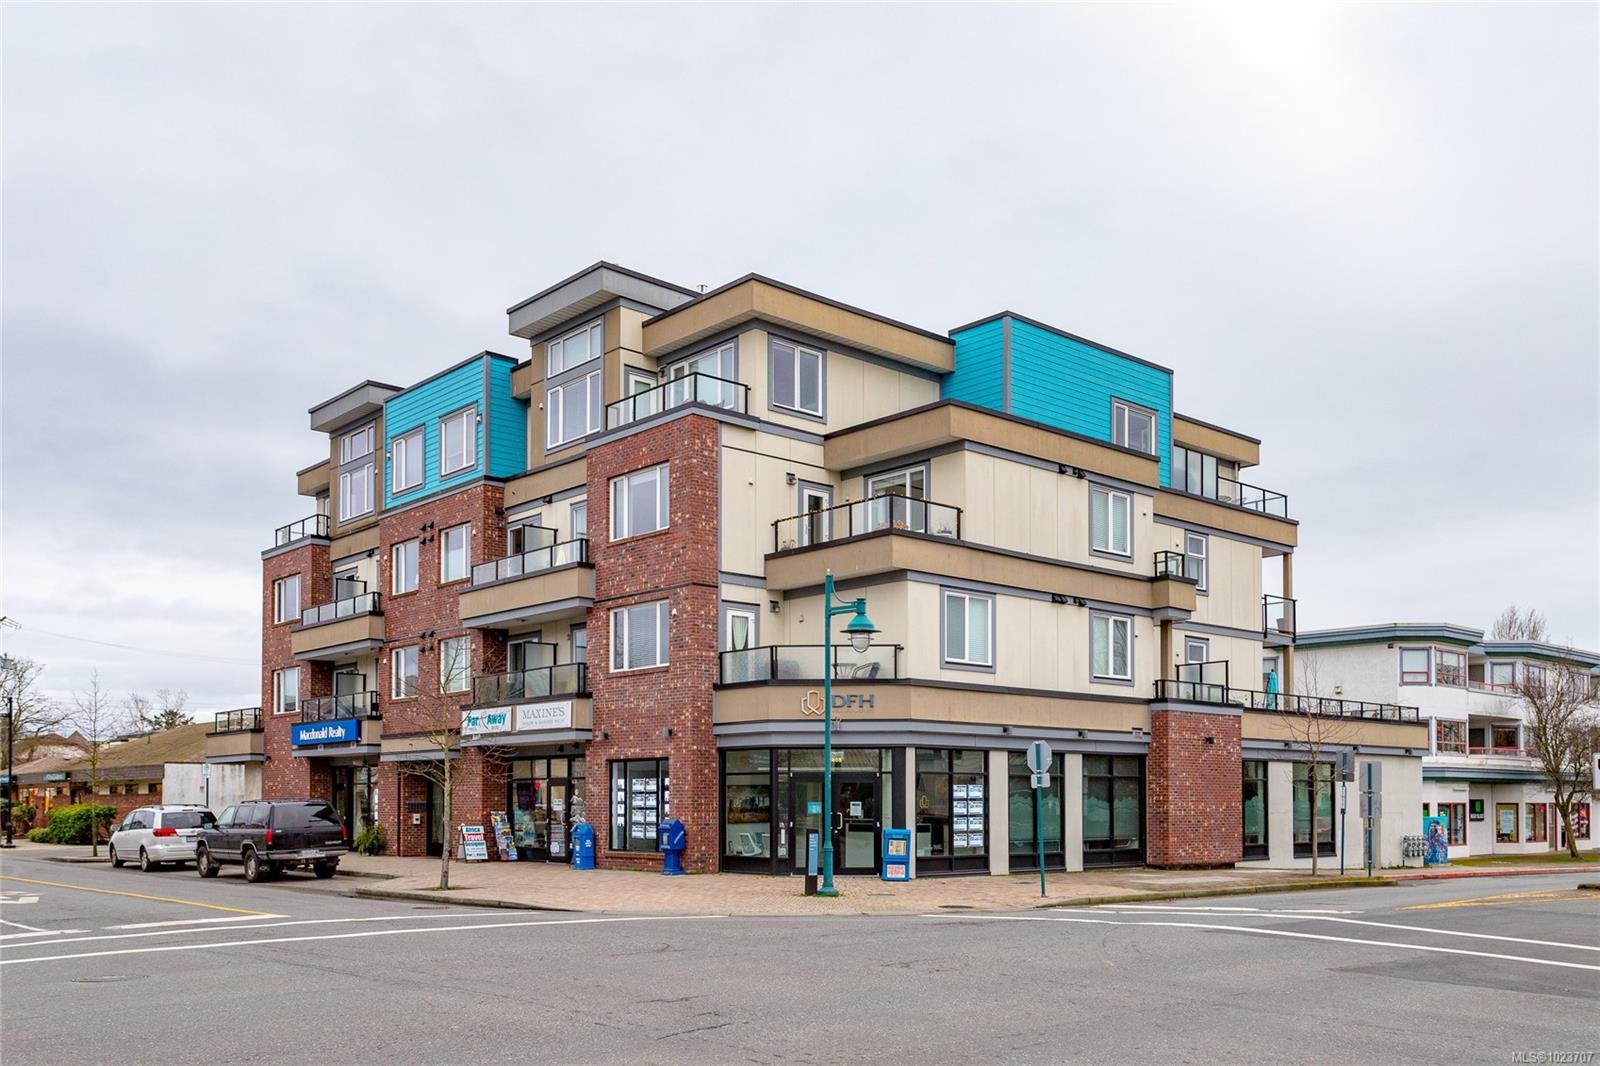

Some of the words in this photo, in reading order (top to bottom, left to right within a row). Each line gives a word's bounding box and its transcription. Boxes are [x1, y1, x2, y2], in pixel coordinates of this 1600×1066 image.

[832, 694, 875, 709] DFH
[467, 715, 480, 726] Far
[486, 712, 507, 726] Away
[522, 706, 565, 720] MAXINE'S
[300, 727, 328, 740] Macdonald
[329, 725, 345, 739] Realty
